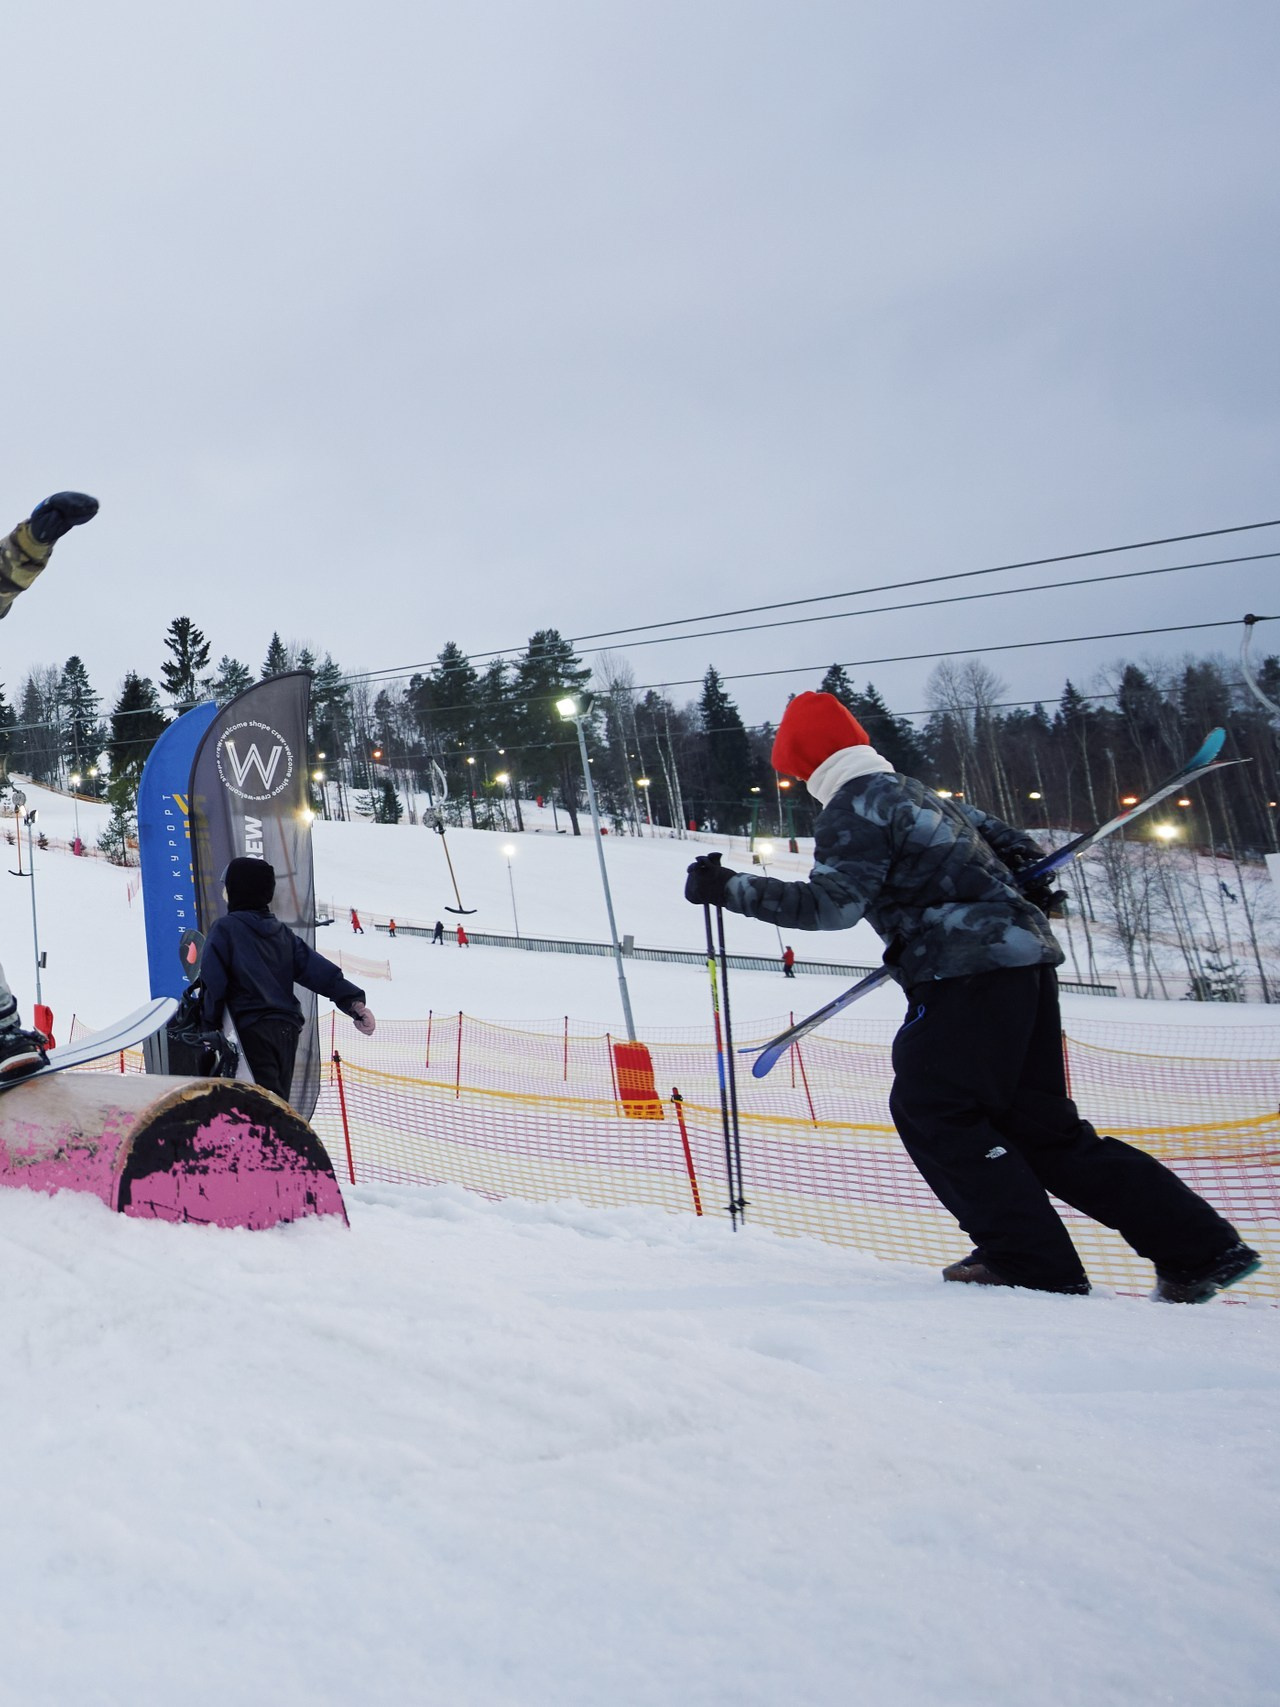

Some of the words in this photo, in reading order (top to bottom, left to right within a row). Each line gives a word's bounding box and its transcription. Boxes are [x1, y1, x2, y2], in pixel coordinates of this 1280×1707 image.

[221, 721, 248, 740] welcome
[249, 720, 271, 731] shape
[271, 729, 286, 744] crew
[224, 740, 283, 790] W
[162, 795, 181, 877] КУРОРТ
